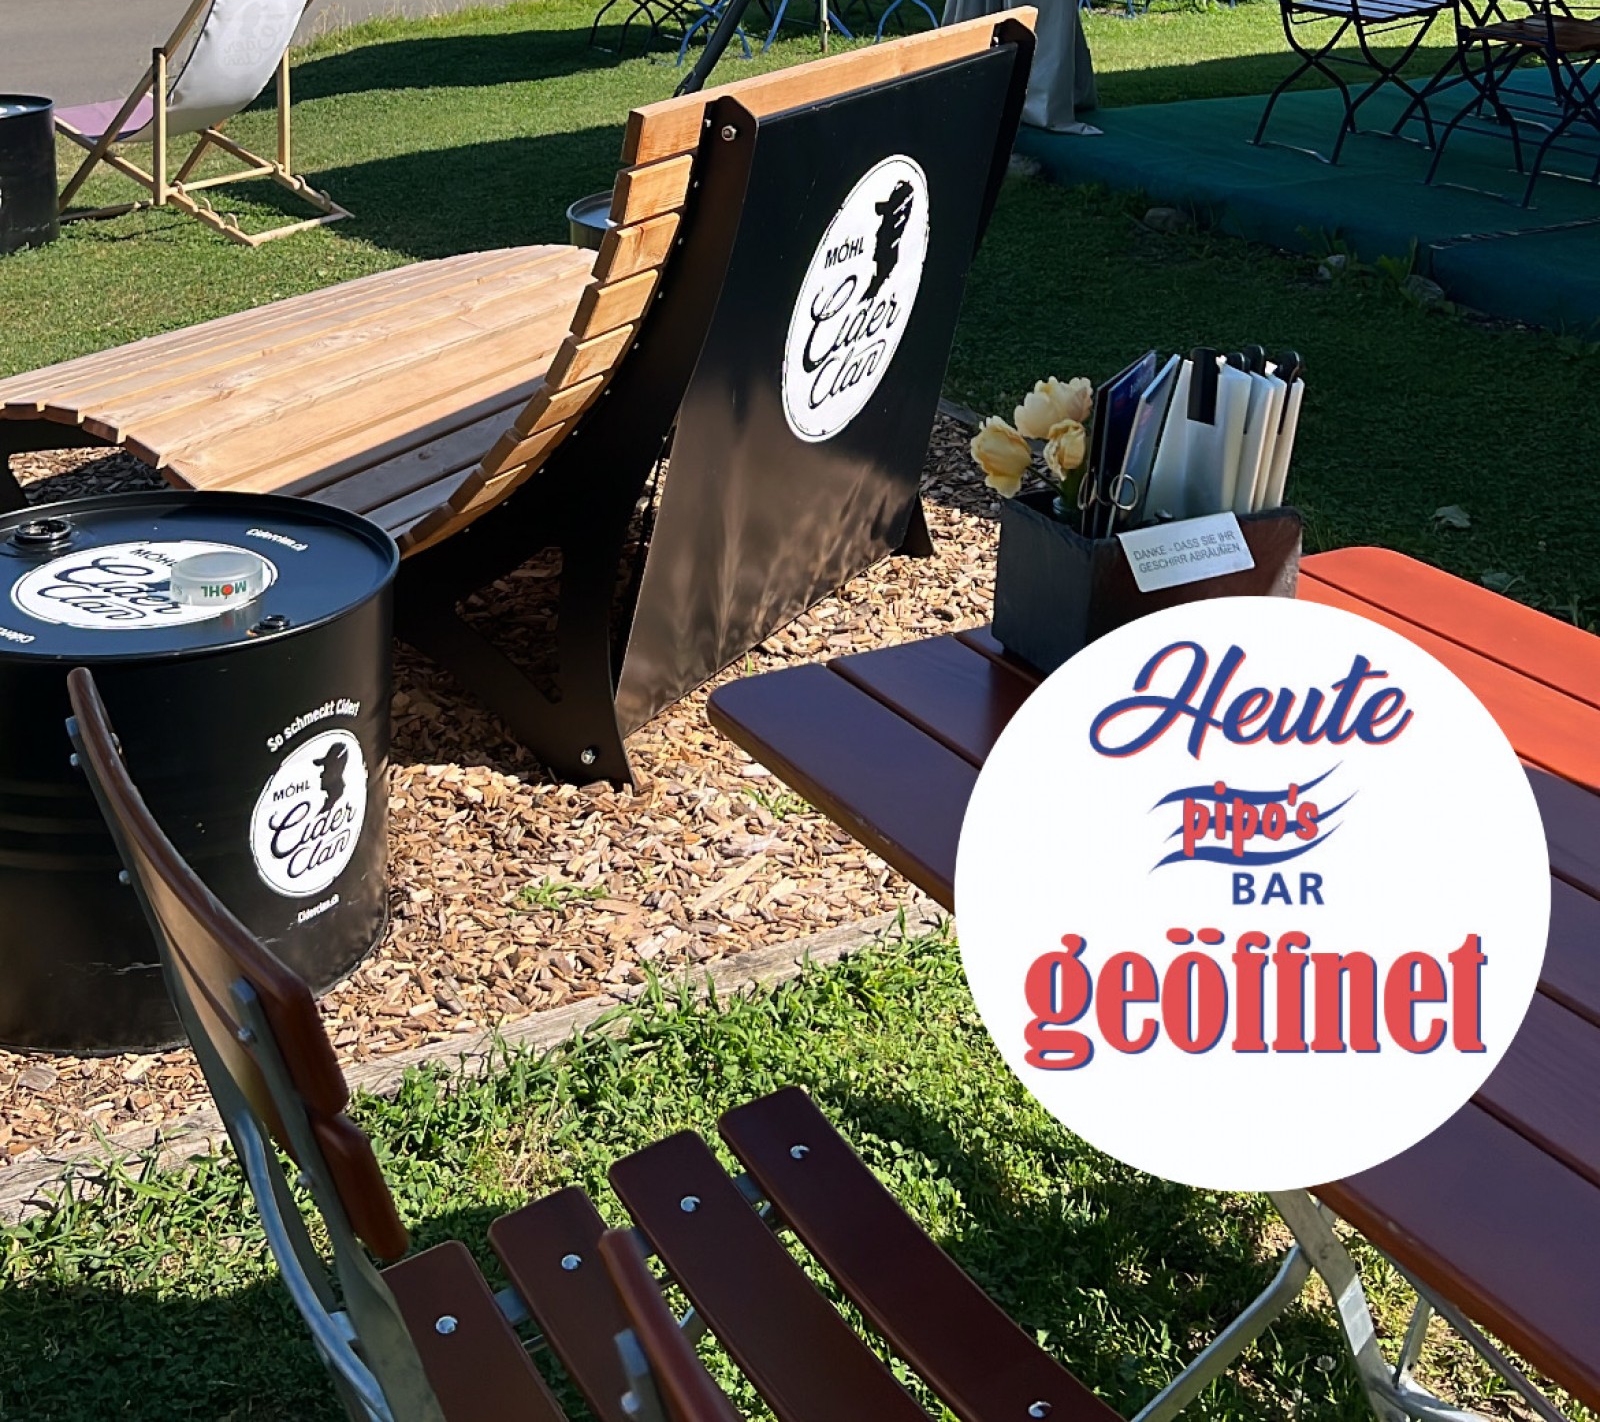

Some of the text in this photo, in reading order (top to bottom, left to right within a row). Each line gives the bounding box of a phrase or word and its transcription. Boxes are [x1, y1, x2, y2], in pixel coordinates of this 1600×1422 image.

[802, 274, 901, 373] Cider
[808, 338, 886, 410] Clan
[1133, 545, 1167, 561] DANKE
[1173, 538, 1200, 553] DASS
[1201, 534, 1218, 547] SIE
[1218, 530, 1236, 543] IHR
[1138, 554, 1187, 574] GESCHIRR
[37, 584, 147, 620] Clan
[266, 733, 285, 753] So
[283, 700, 335, 740] schmeckt
[268, 800, 358, 859] Cider
[287, 829, 351, 878] Clan
